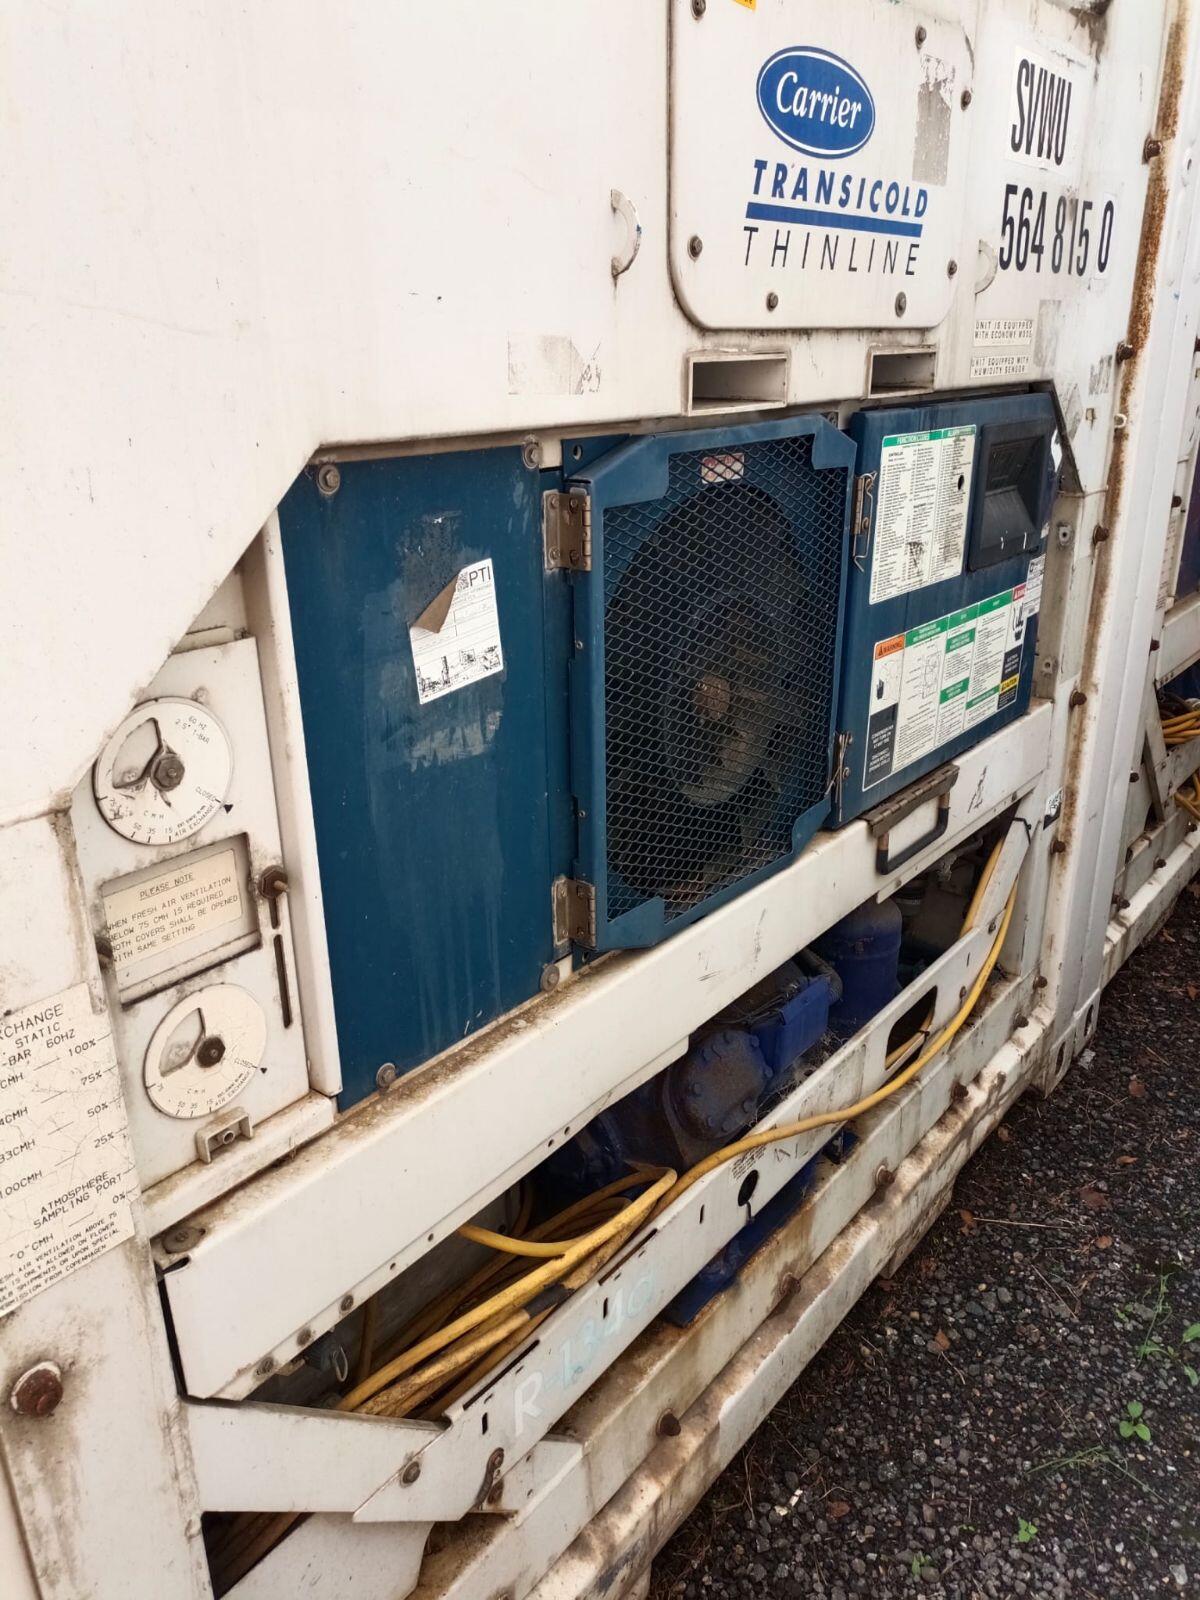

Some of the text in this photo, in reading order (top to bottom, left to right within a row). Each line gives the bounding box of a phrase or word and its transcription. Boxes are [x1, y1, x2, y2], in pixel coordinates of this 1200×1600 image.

[776, 71, 862, 128] Carrier
[1011, 59, 1072, 166] SVWU
[753, 159, 928, 218] TRANSICOLD
[743, 226, 919, 276] THINLINE
[1097, 200, 1114, 273] 0
[975, 330, 989, 339] WITH
[991, 330, 1016, 339] ECONOMY
[976, 321, 1033, 330] UNIT IS EQUIPPED
[971, 358, 985, 367] UNIT
[988, 357, 1015, 366] EQUIPPED
[974, 365, 1025, 376] HUMIDITY SENSOR
[468, 567, 491, 587] PTI
[195, 786, 216, 802] CLOSED
[165, 824, 173, 834] 15
[175, 828, 187, 837] AIR
[189, 804, 214, 831] EXCHANGE
[132, 906, 157, 921] FRESH
[162, 899, 176, 911] AIR
[180, 876, 232, 901] VENTILATION
[139, 872, 194, 899] PLEASE NOTE
[135, 925, 166, 942] COVERS
[169, 915, 194, 929] SHALL
[198, 909, 207, 917] BE
[211, 895, 239, 911] OPENED
[139, 921, 150, 930] 75
[153, 913, 169, 923] CMH
[173, 906, 183, 916] IS
[187, 890, 224, 911] REQUIRED
[137, 940, 159, 953] SAME
[161, 924, 196, 943] SETTING
[15, 1022, 61, 1048] STATIC
[46, 1028, 76, 1049] 60HZ
[68, 1038, 97, 1057] 100%
[80, 1070, 103, 1086] 75%
[87, 1102, 109, 1118] 50%
[94, 1132, 115, 1149] 25%
[34, 1173, 122, 1229] SAMPLING PORT
[40, 1171, 109, 1215] ATMOSPHERE
[112, 1192, 126, 1204] 0%
[17, 1266, 57, 1291] SHIPMENTS
[72, 1246, 89, 1259] UPON
[92, 1228, 119, 1247] SPECIAL
[18, 1261, 31, 1273] AIR
[36, 1232, 82, 1262] VENTILATION
[85, 1219, 104, 1233] ABOVE
[24, 1265, 41, 1279] ONLY
[46, 1245, 75, 1265] ALLOWED
[90, 1221, 115, 1239] FLOWER
[44, 1270, 63, 1284] FROM
[65, 1244, 107, 1272] COPENHAGEN
